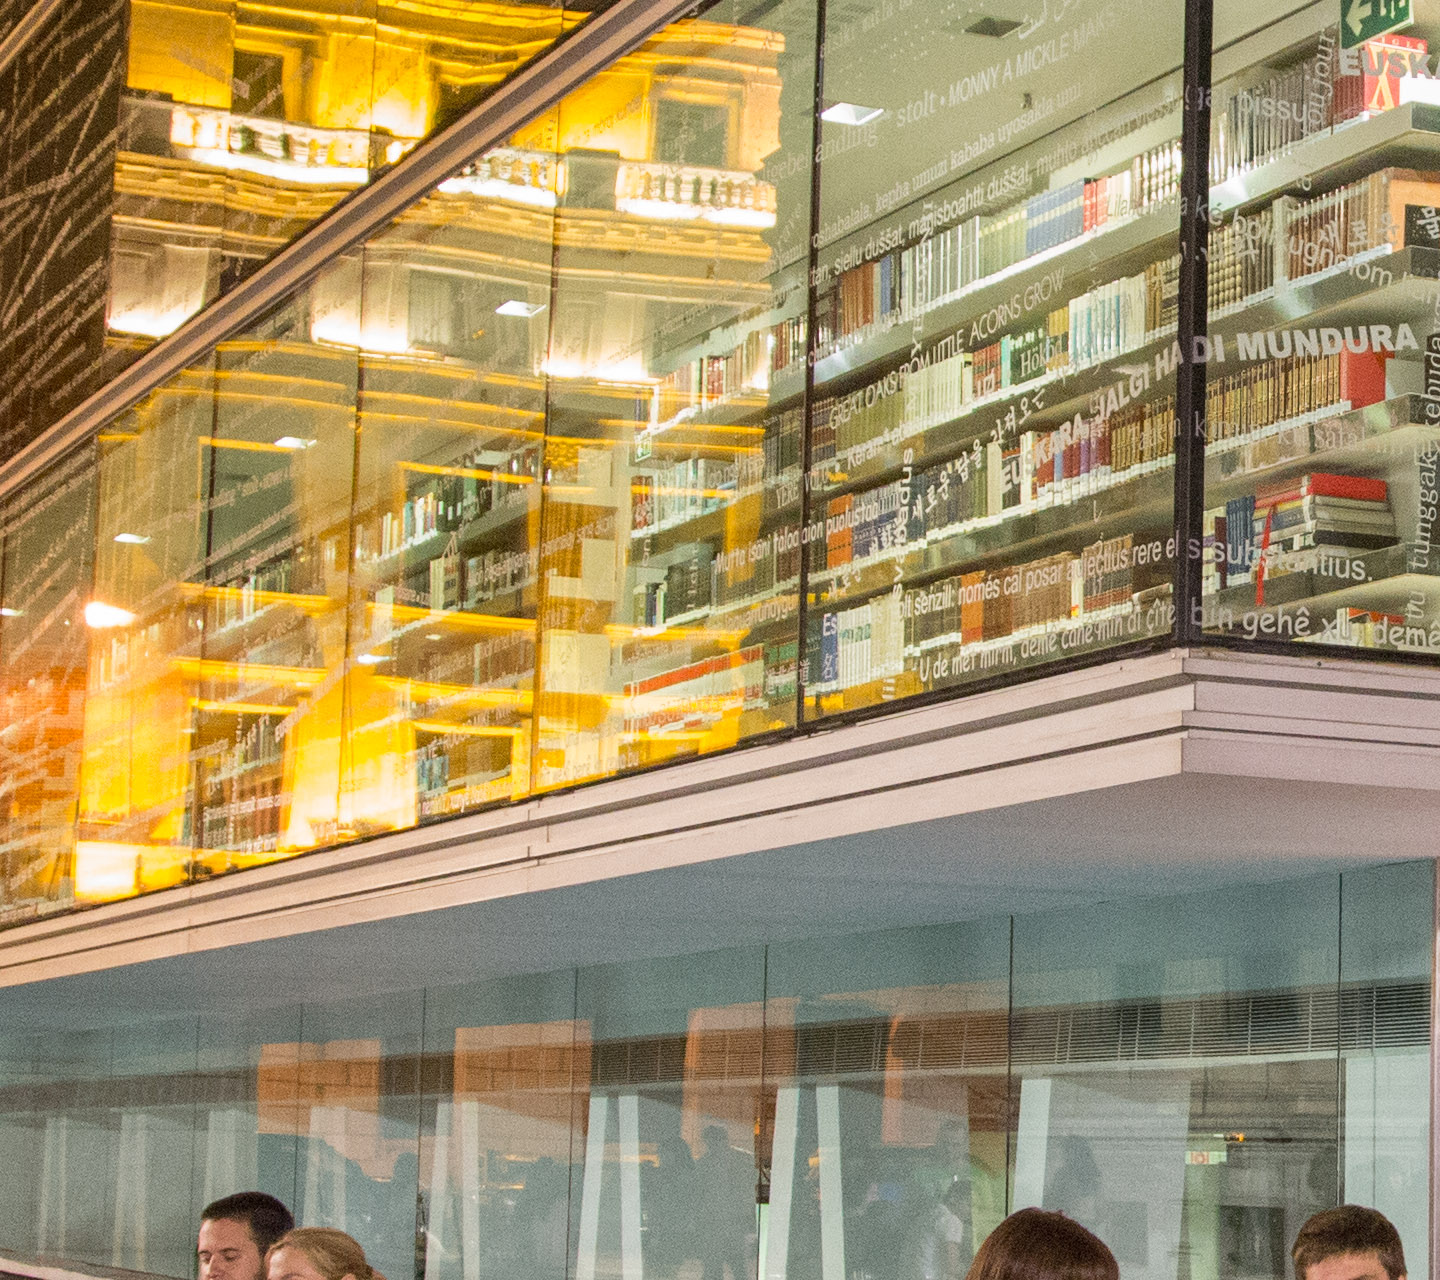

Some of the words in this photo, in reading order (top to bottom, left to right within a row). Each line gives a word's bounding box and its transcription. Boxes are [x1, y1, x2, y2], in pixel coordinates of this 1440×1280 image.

[968, 297, 1023, 348] ACORNS
[1022, 270, 1066, 312] GROW
[1236, 322, 1422, 363] MUNDURA
